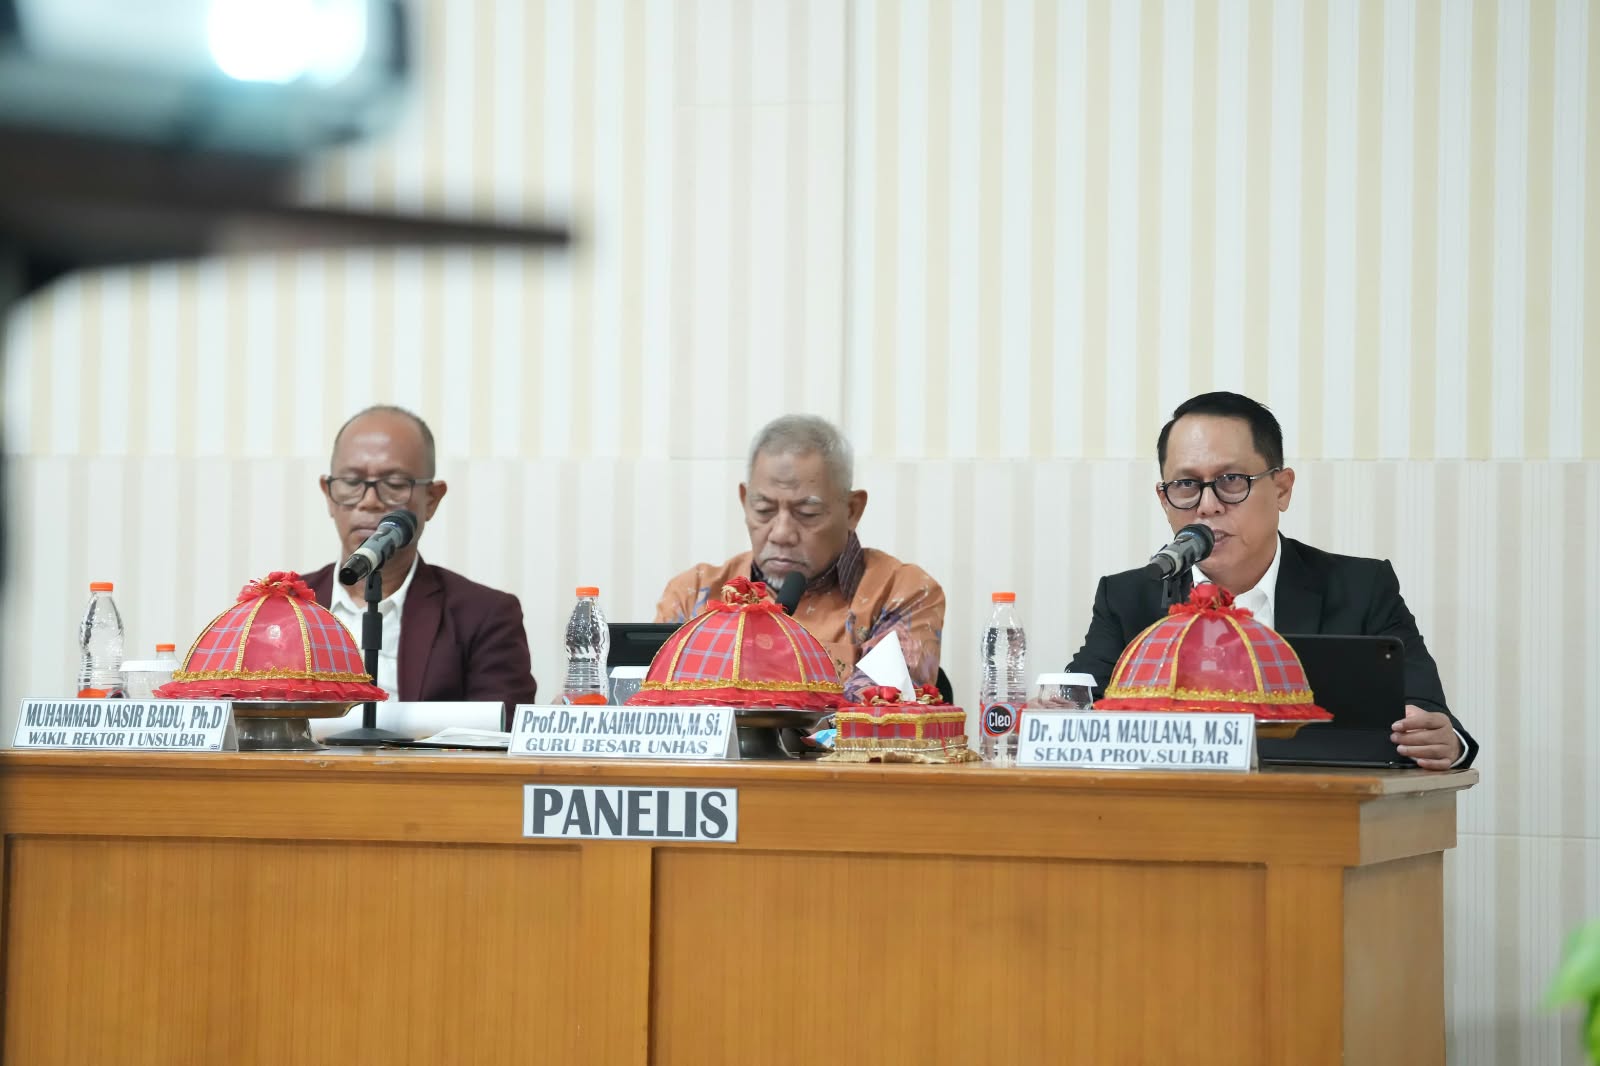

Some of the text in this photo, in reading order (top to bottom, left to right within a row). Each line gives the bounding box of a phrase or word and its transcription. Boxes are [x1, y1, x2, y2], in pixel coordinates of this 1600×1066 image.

[25, 704, 222, 731] MUHAMMAD NASIR BADU, Ph.D
[988, 711, 1011, 727] Cleo
[28, 731, 67, 745] WAKIL
[72, 732, 125, 746] REKTOR
[128, 732, 135, 746] I
[137, 732, 206, 747] UNSULBAR
[1028, 718, 1243, 747] Dr. JUNDA MAULANA, M.Si.
[526, 738, 708, 754] GURU BESAR UNHAS
[1034, 747, 1229, 764] SEKDA PROV.SULBAR
[532, 788, 729, 839] PANELIS
